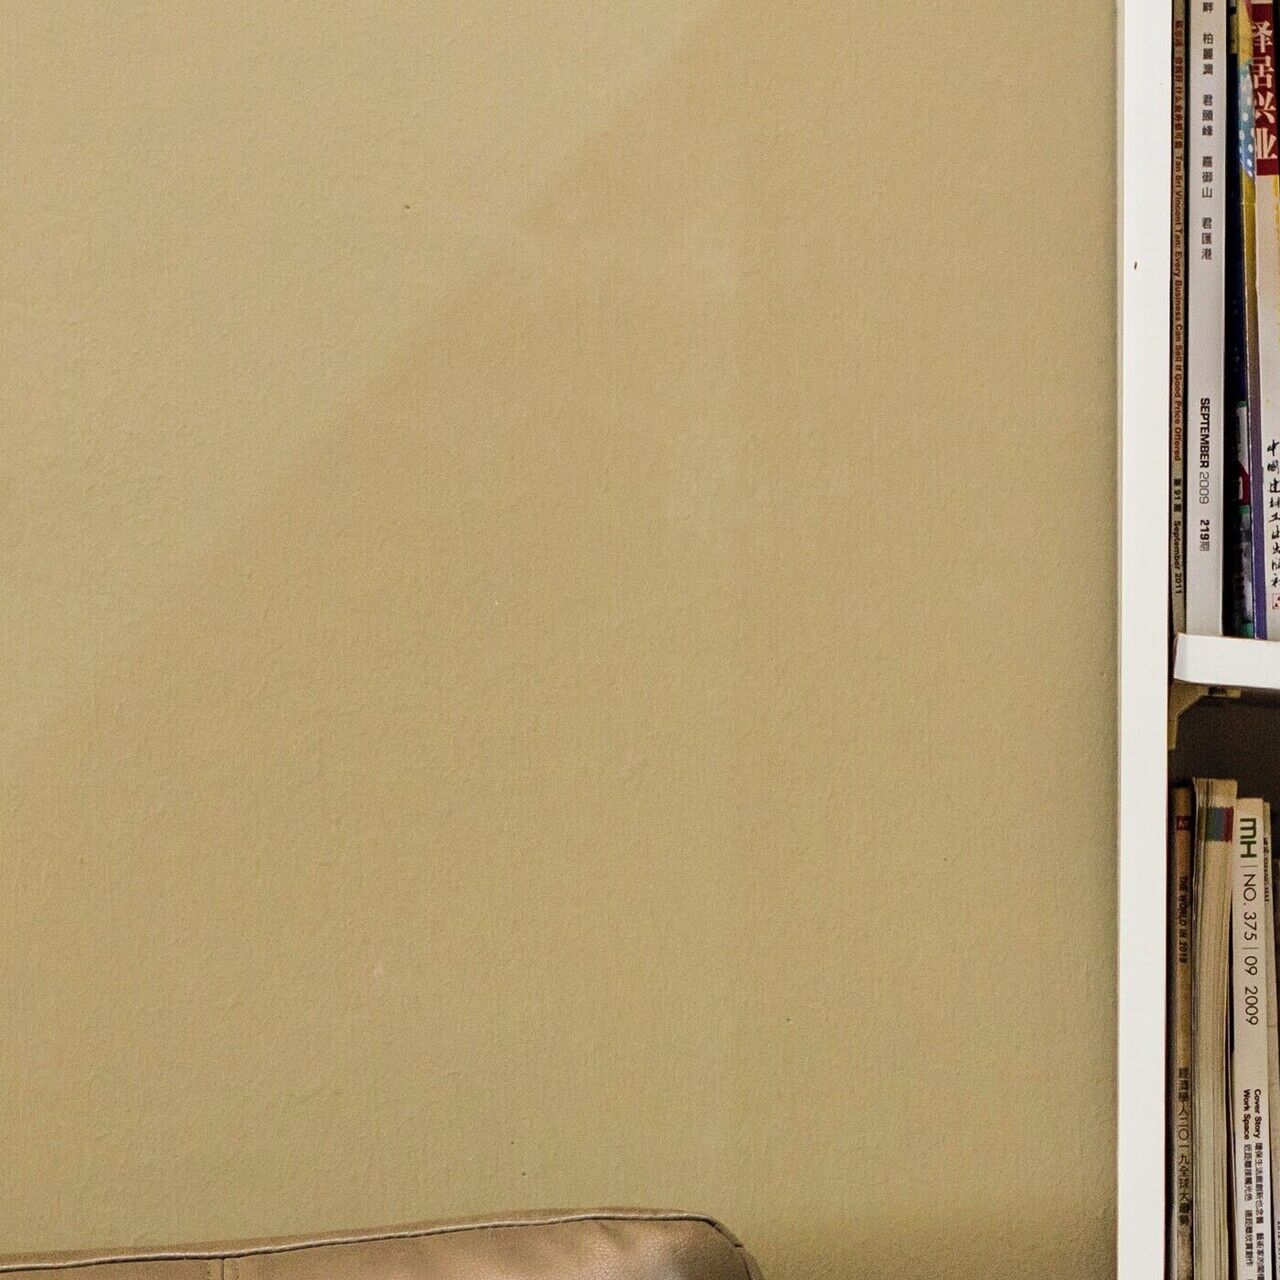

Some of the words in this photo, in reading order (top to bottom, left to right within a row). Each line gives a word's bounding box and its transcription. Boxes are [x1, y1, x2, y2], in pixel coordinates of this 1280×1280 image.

[1199, 397, 1210, 468] SEPTEMBER
[1199, 471, 1210, 504] 2009
[1242, 874, 1257, 906] NO.
[1243, 911, 1257, 941] 375
[1244, 955, 1258, 977] 09
[1245, 988, 1259, 1026] 2009
